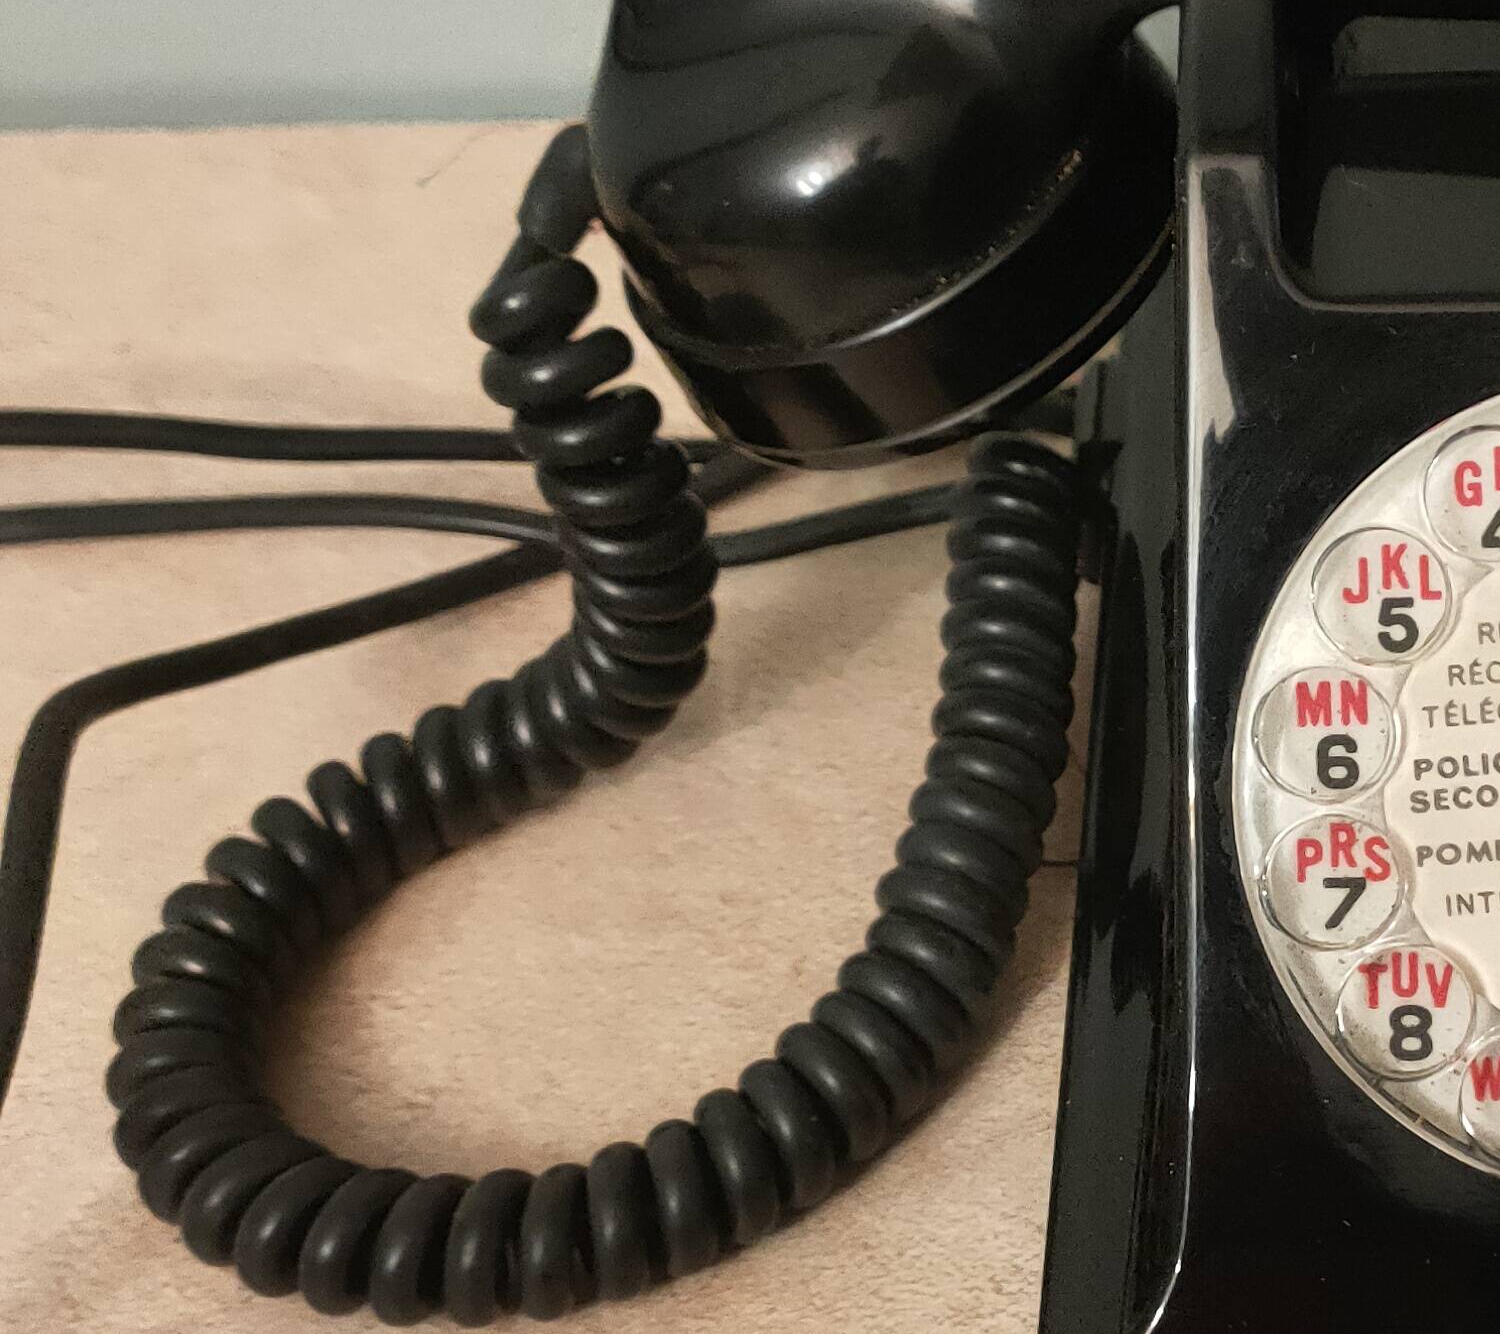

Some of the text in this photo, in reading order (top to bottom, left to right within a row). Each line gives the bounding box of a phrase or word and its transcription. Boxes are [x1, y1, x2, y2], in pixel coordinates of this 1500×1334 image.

[1342, 543, 1442, 604] JKL
[1378, 597, 1419, 653] 5
[1296, 680, 1368, 727] MN
[1316, 734, 1359, 789] 6
[1296, 822, 1391, 883] PRS
[1323, 877, 1366, 929] 7
[1358, 952, 1453, 1009] TUV
[1389, 1005, 1433, 1061] 8
